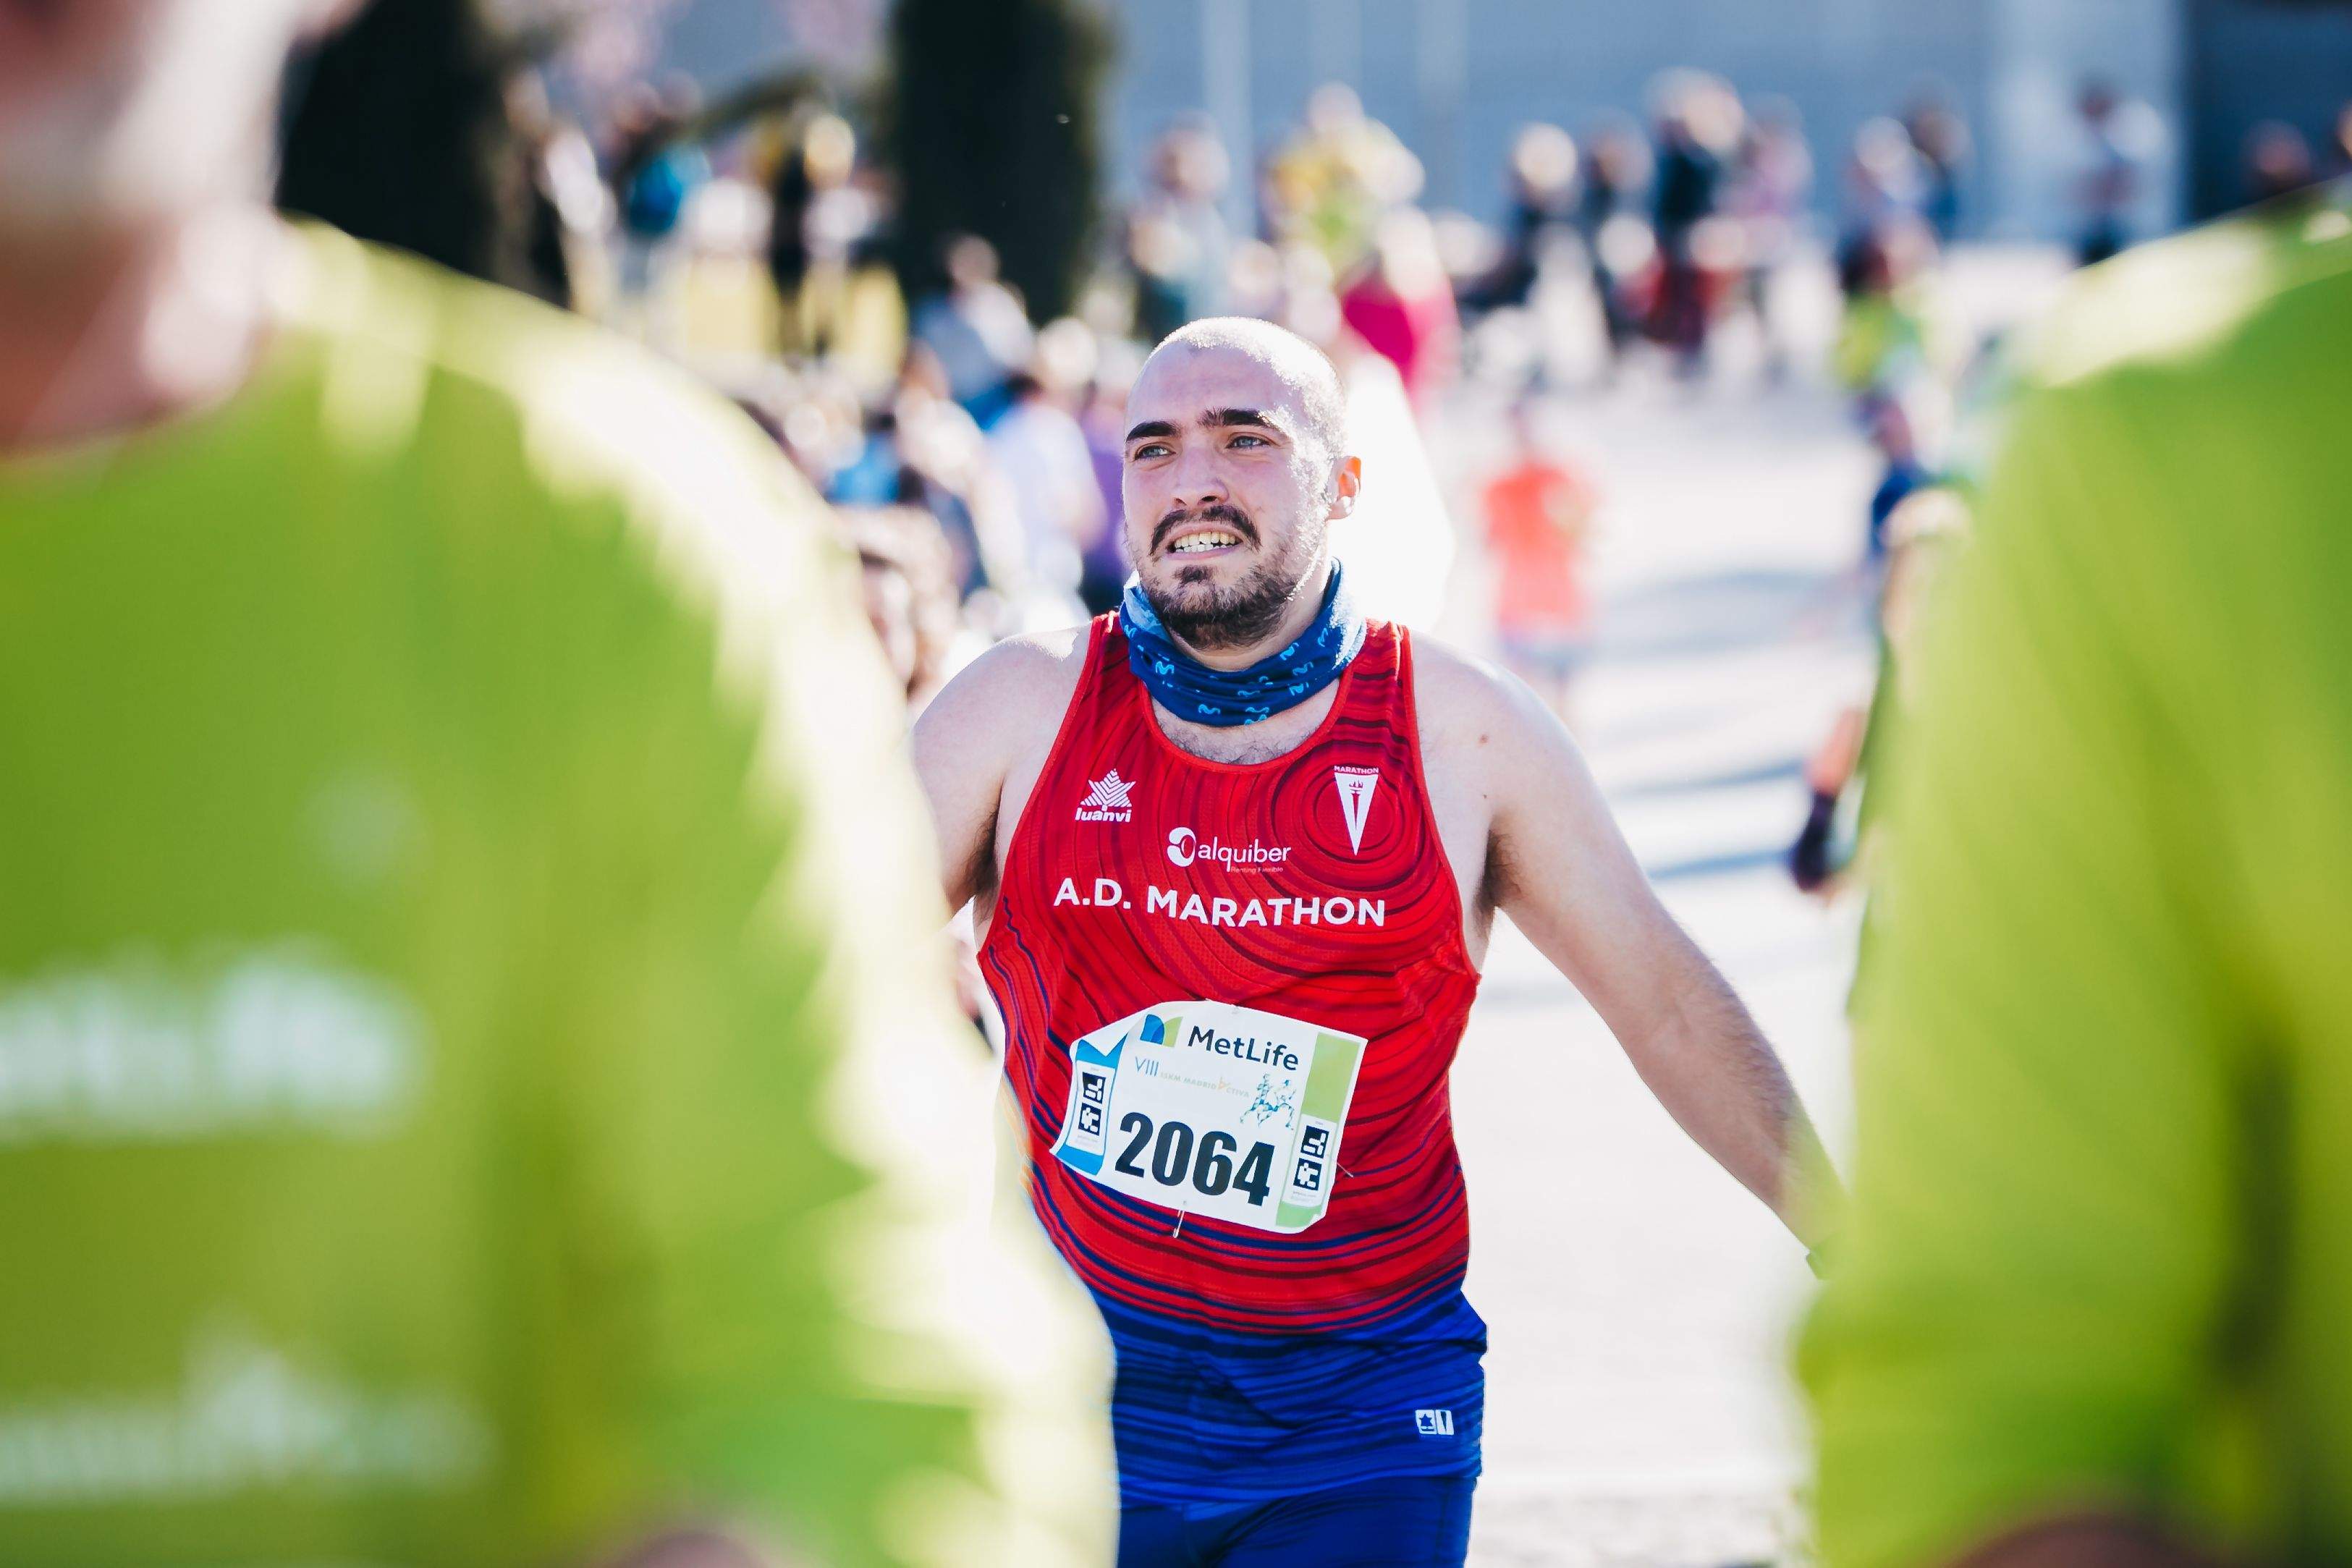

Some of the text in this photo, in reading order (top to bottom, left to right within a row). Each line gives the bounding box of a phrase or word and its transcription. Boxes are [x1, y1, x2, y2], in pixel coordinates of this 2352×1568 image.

[1334, 765, 1379, 774] MARATHON
[1075, 808, 1132, 822] luanvi
[1198, 836, 1292, 873] alquiber
[1054, 877, 1386, 928] A.D. MARATHON
[1135, 1056, 1159, 1077] VIII
[1188, 1025, 1299, 1071] MetLife
[1114, 1111, 1276, 1207] 2064
